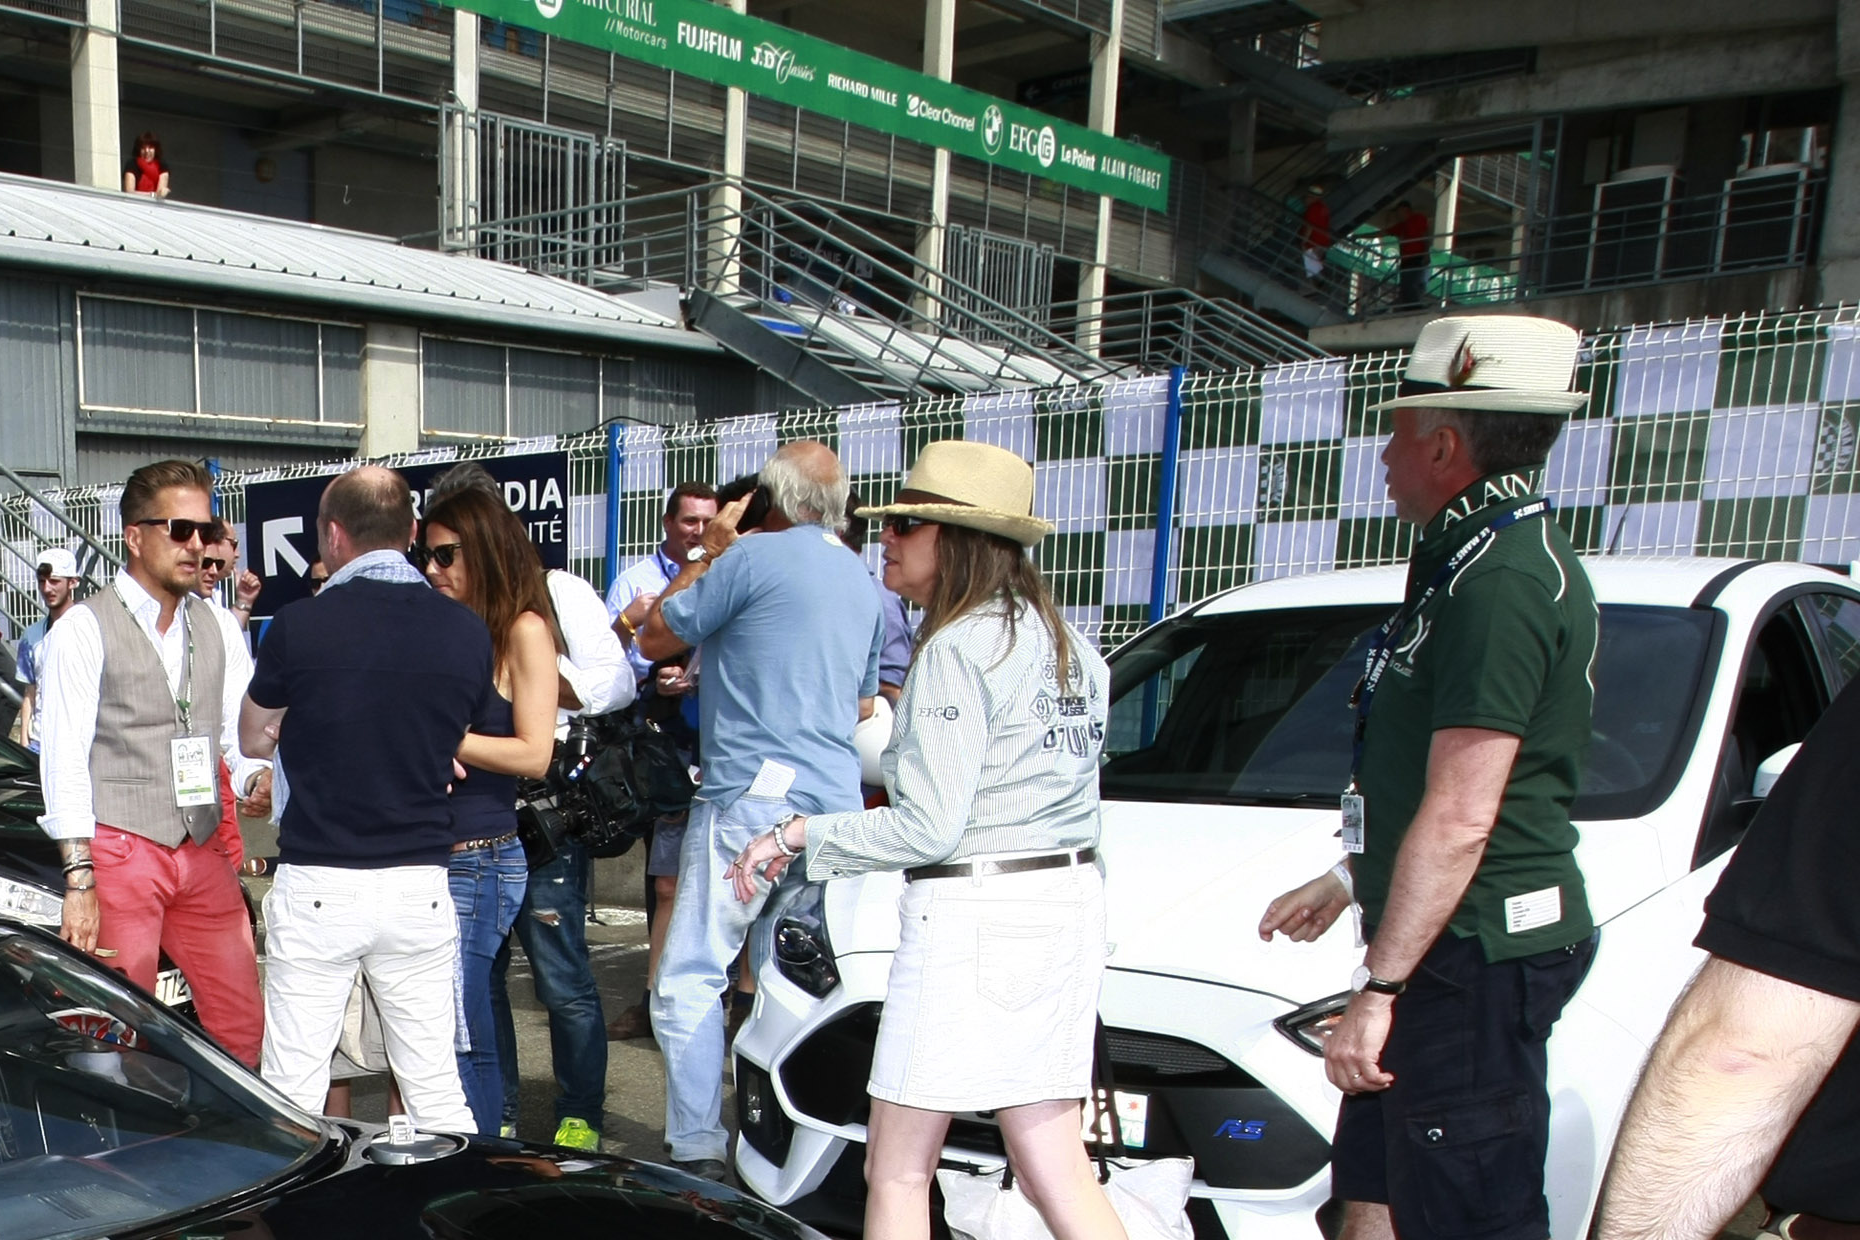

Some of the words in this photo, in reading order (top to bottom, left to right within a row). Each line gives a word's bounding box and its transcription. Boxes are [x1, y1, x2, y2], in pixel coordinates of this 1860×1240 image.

[677, 21, 742, 62] FUJIFILM
[827, 73, 869, 98] RICHARD
[870, 86, 898, 107] MILLE
[919, 100, 942, 122] Clear
[941, 107, 976, 132] Channel
[1009, 123, 1038, 156] EFG
[1061, 144, 1071, 164] Le
[1071, 148, 1097, 172] Point
[1100, 156, 1126, 179] ALAIN
[1127, 164, 1162, 191] FIGARET
